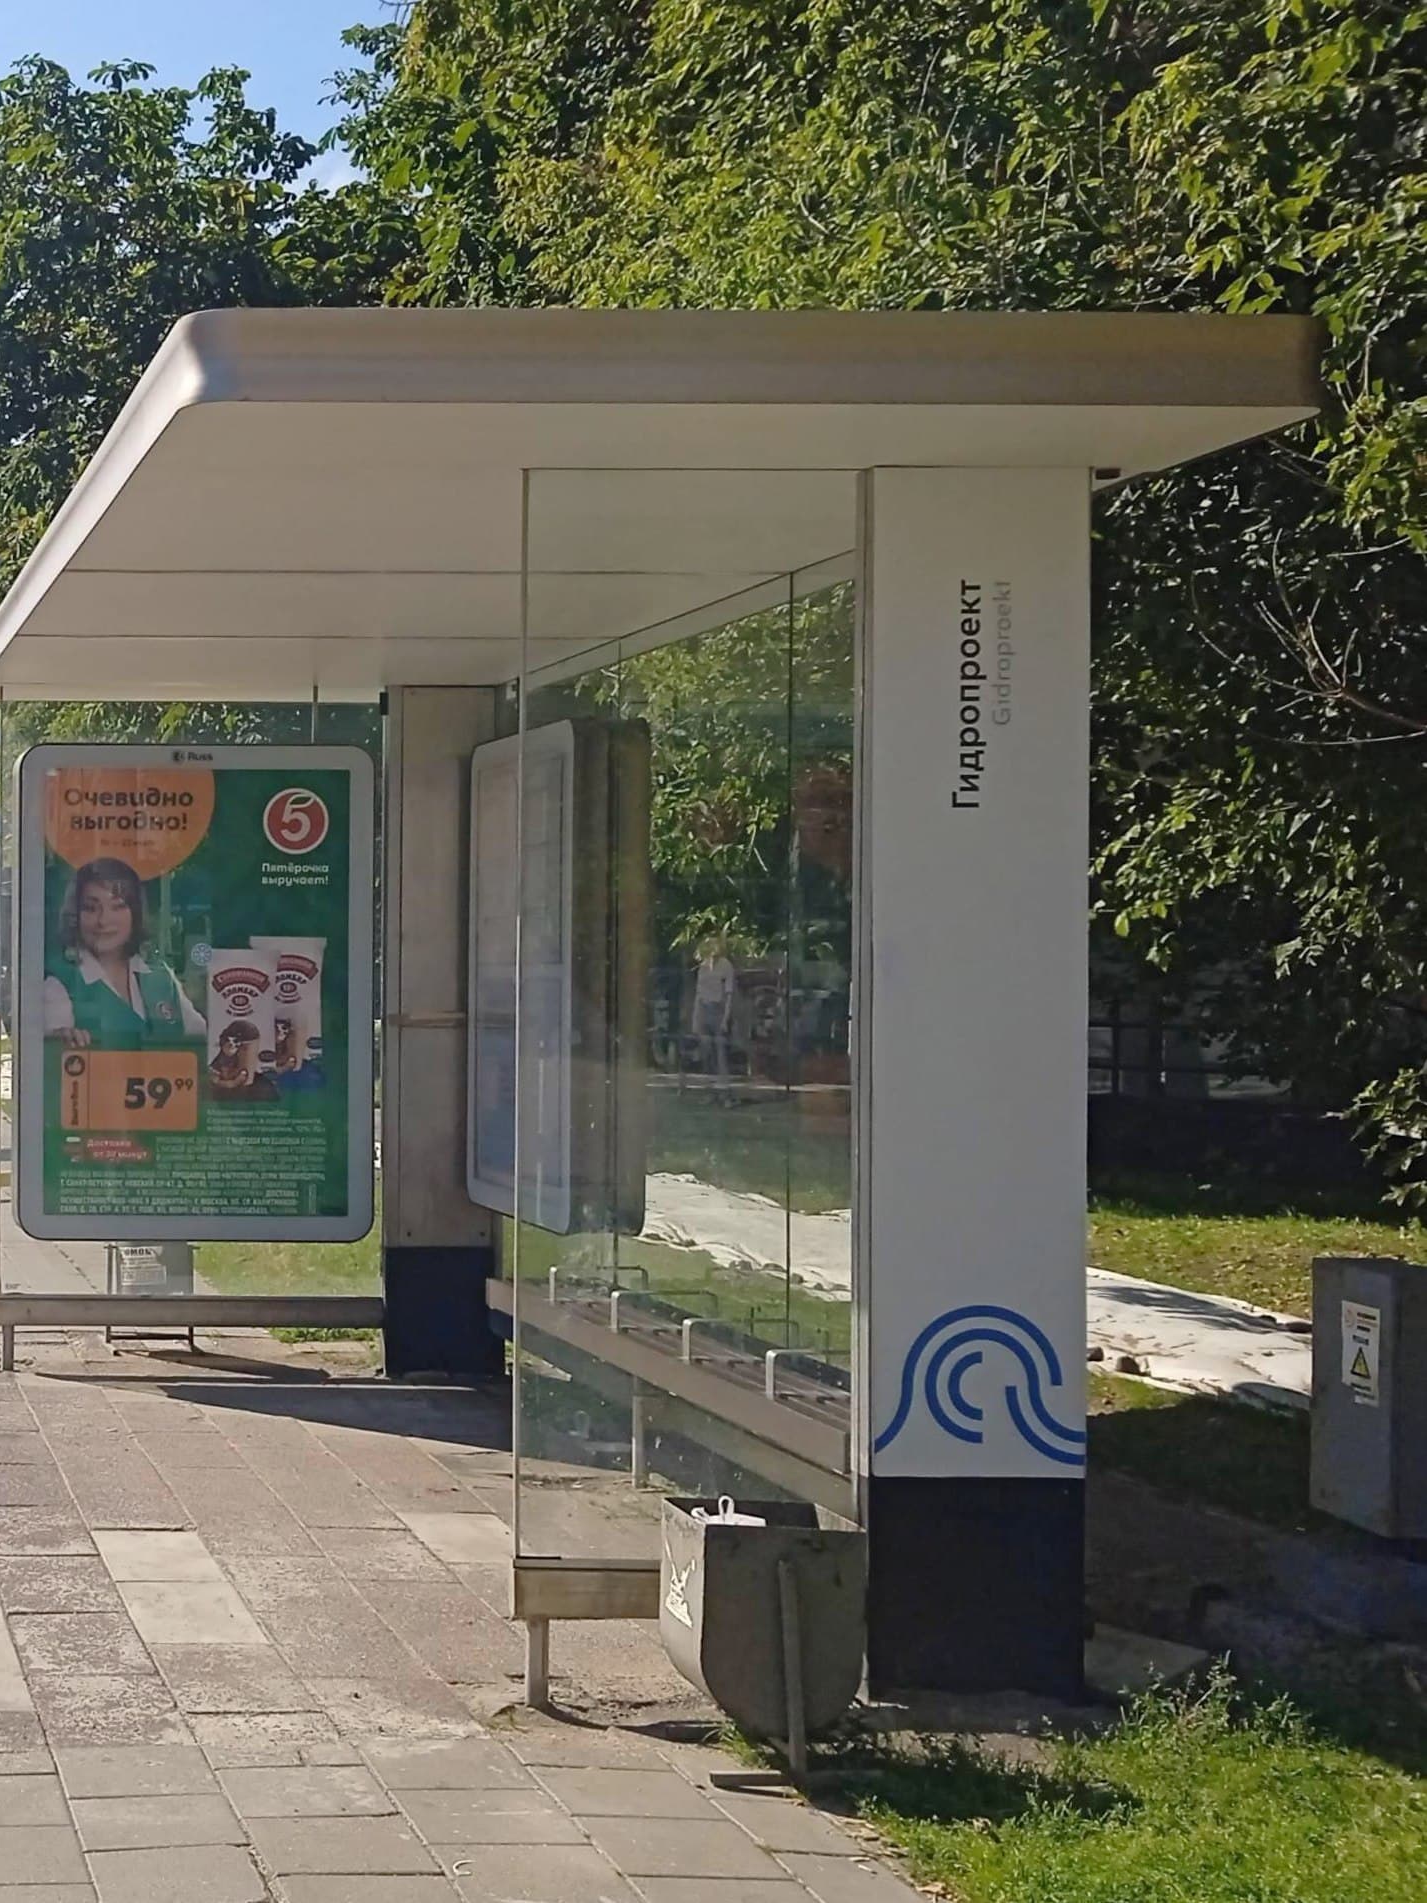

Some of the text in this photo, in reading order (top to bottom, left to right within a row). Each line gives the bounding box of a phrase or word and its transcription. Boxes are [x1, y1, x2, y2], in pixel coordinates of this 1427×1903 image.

[992, 580, 1016, 725] Gidroproekt
[951, 579, 987, 808] Гидропроект
[64, 788, 194, 807] Очевидно
[70, 811, 188, 831] выгодно!
[262, 862, 329, 875] Пятёрочка
[262, 876, 329, 887] выручает!
[124, 1077, 194, 1110] 59 99
